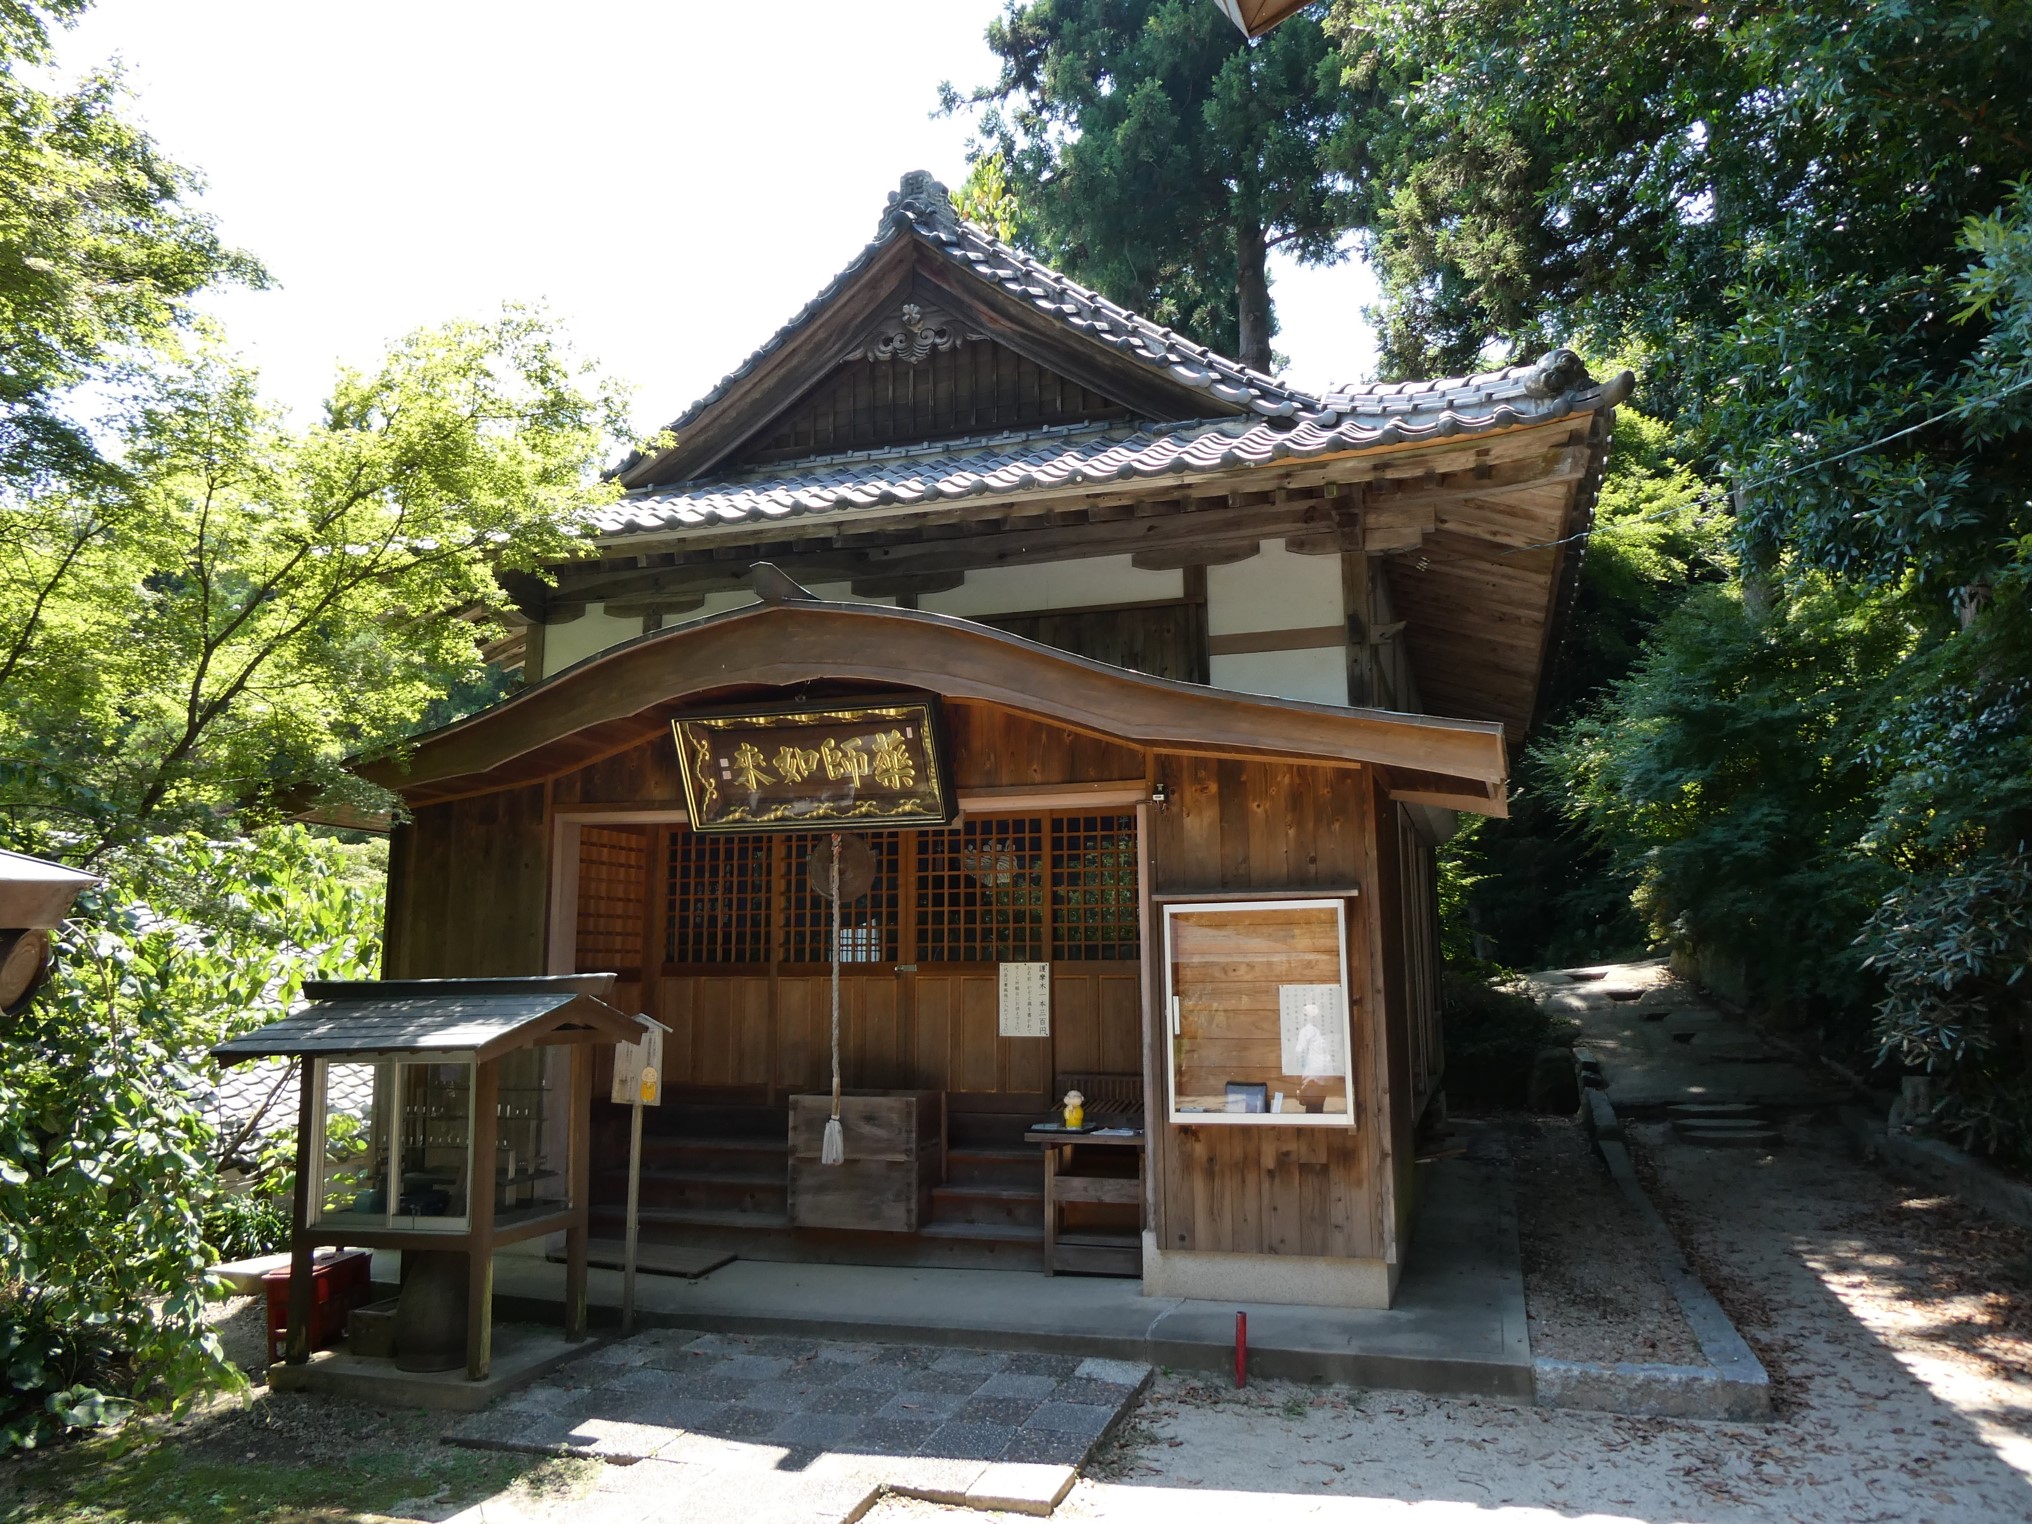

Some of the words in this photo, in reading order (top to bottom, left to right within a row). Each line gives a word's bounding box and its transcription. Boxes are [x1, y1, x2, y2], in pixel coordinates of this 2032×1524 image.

[1038, 965, 1047, 1035] 護摩木一本三百円
